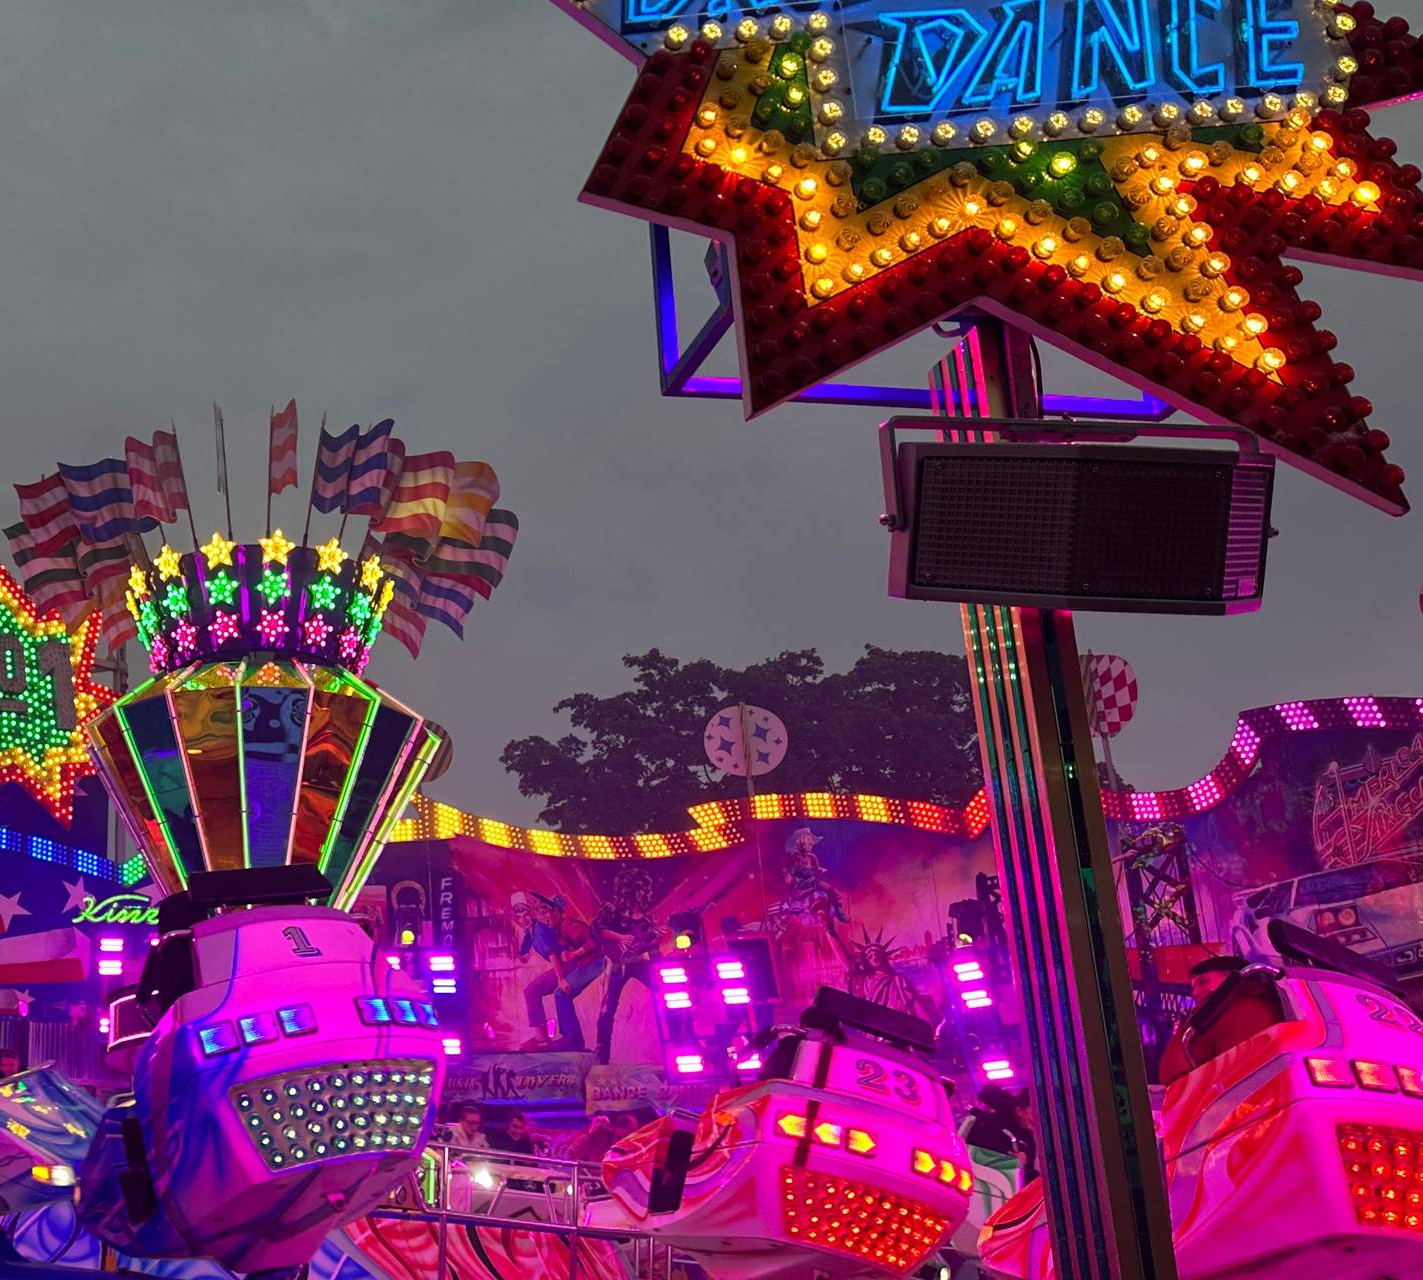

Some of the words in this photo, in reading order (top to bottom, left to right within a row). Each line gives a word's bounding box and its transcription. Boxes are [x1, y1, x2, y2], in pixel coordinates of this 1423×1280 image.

[879, 0, 1304, 112] DANCE
[282, 926, 322, 957] 1
[591, 1086, 648, 1101] DANCE
[855, 1058, 922, 1106] 23
